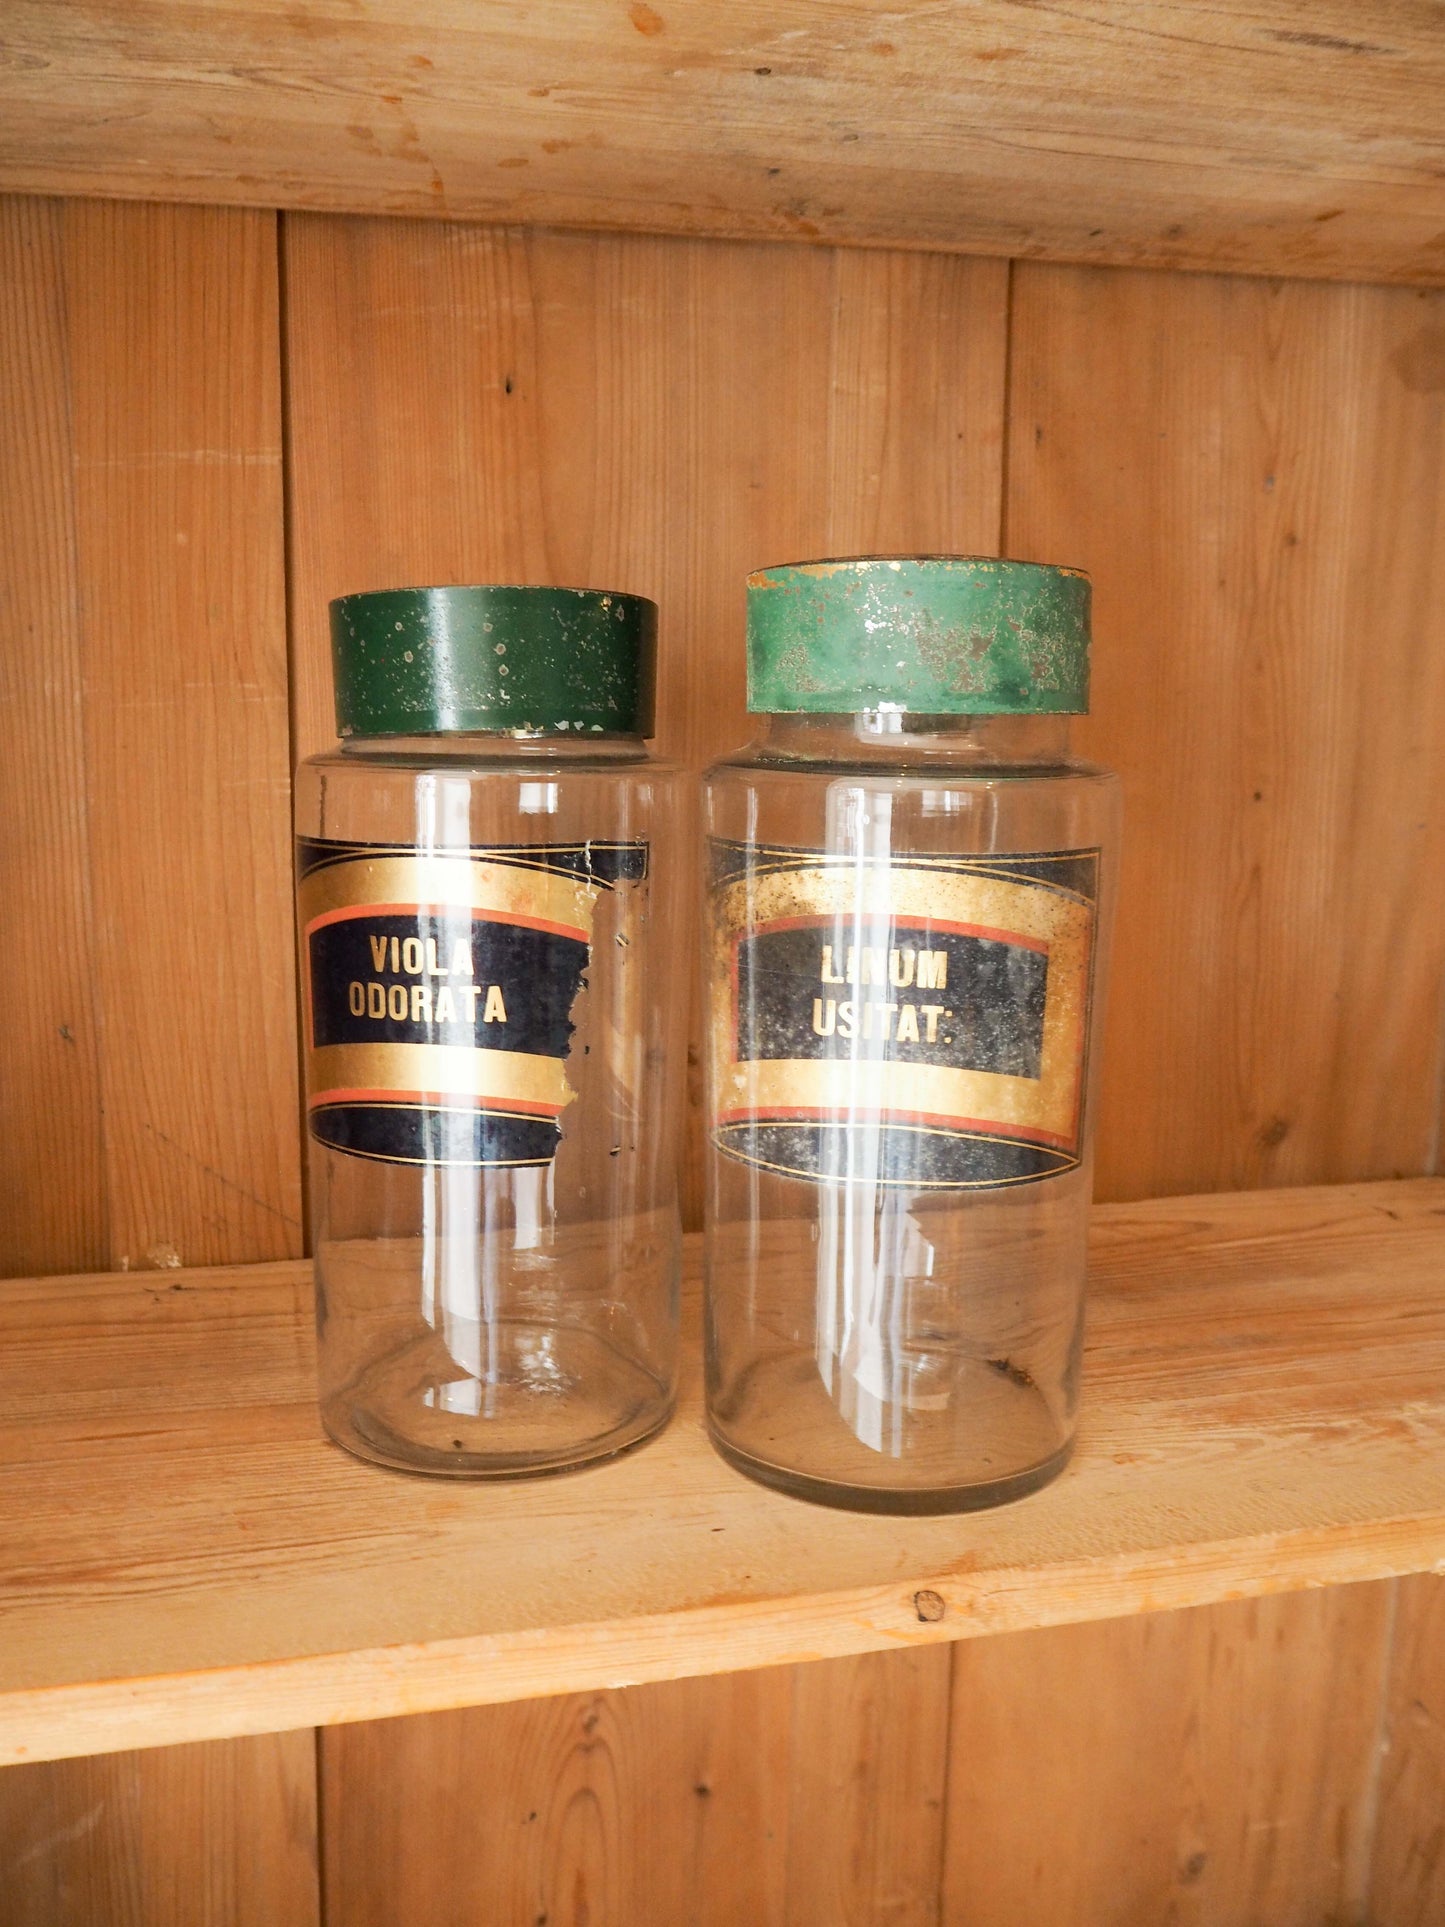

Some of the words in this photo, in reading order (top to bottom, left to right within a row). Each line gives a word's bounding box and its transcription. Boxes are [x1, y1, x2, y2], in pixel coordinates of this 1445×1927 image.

[370, 935, 475, 976] VIOLA
[821, 945, 948, 990] LINUM
[349, 981, 508, 1023] ODORATA
[813, 998, 953, 1044] USITAT:
